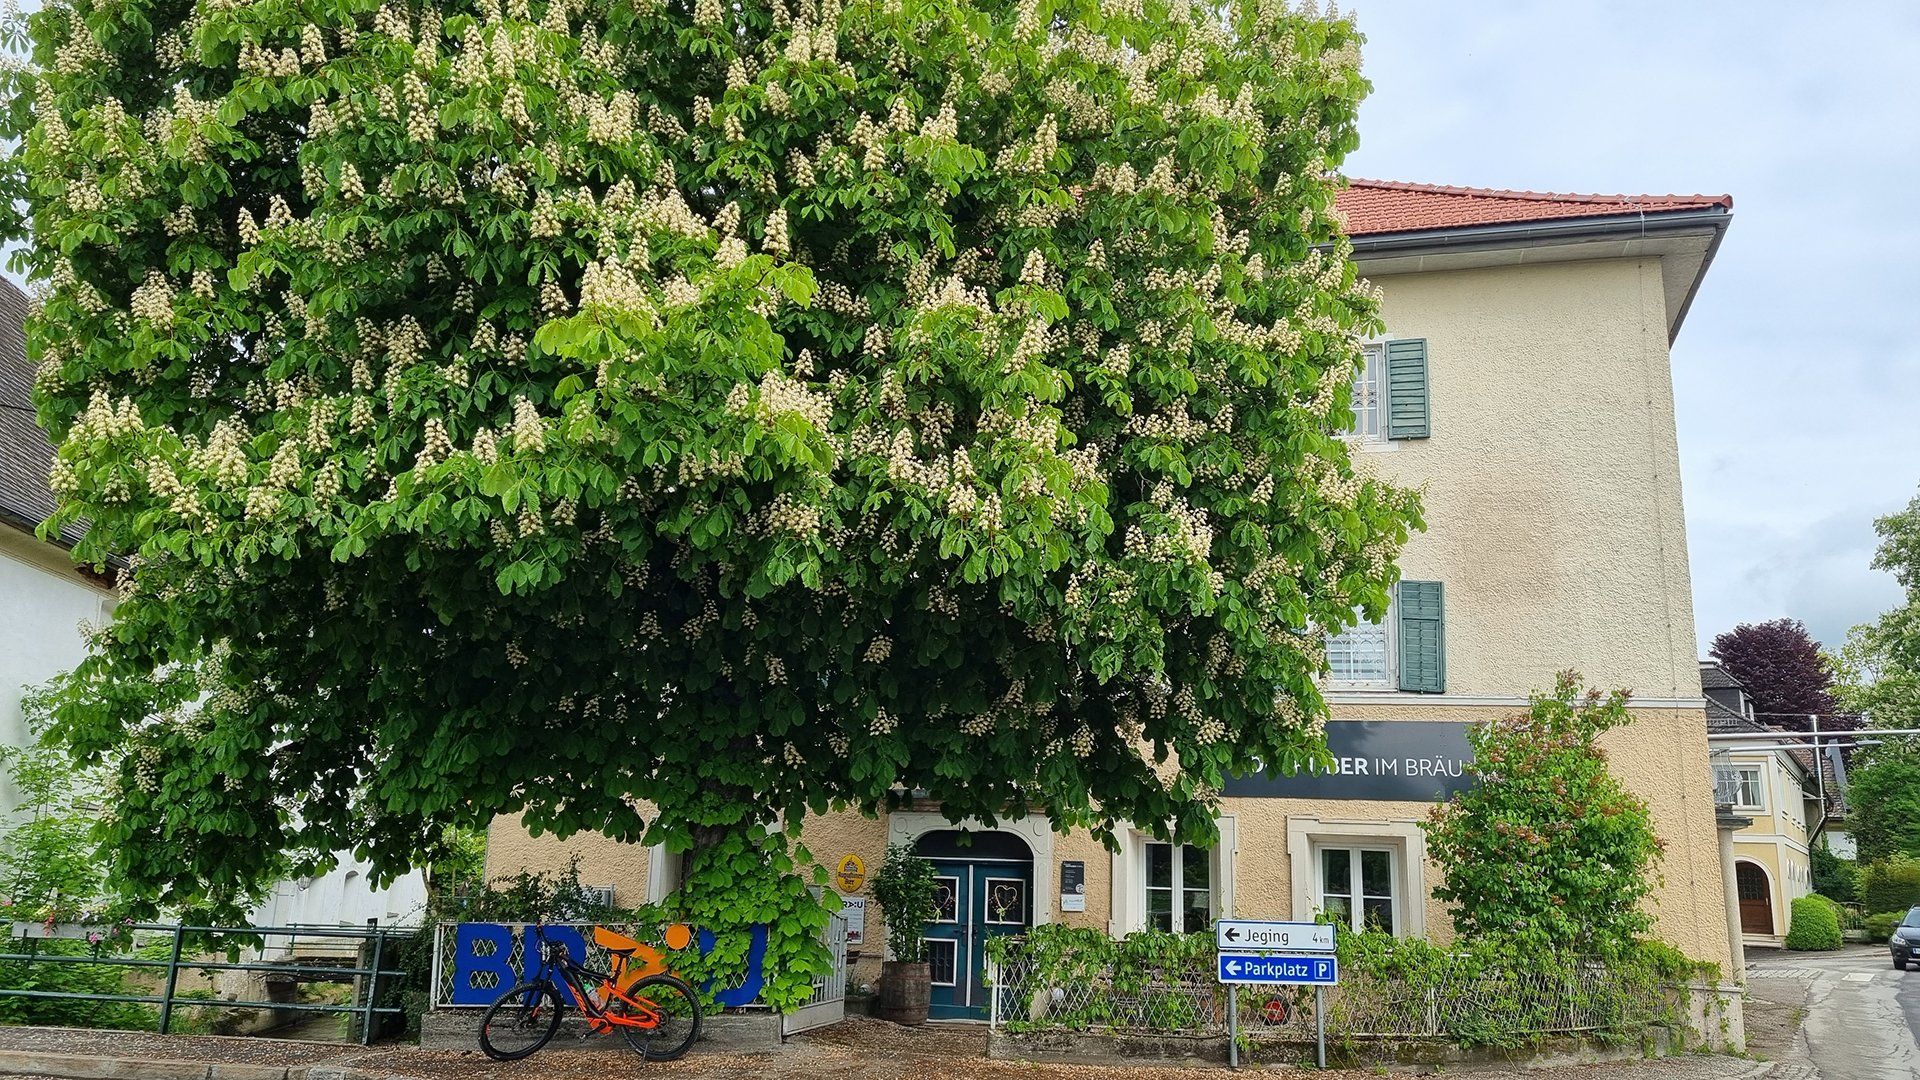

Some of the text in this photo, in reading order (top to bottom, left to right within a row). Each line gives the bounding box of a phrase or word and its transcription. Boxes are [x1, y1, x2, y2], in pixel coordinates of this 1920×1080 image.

[1375, 758, 1398, 776] IM
[1405, 755, 1463, 777] BRÄU
[1244, 928, 1330, 946] Jeging 4 km
[1244, 961, 1327, 979] Parkplatz P
